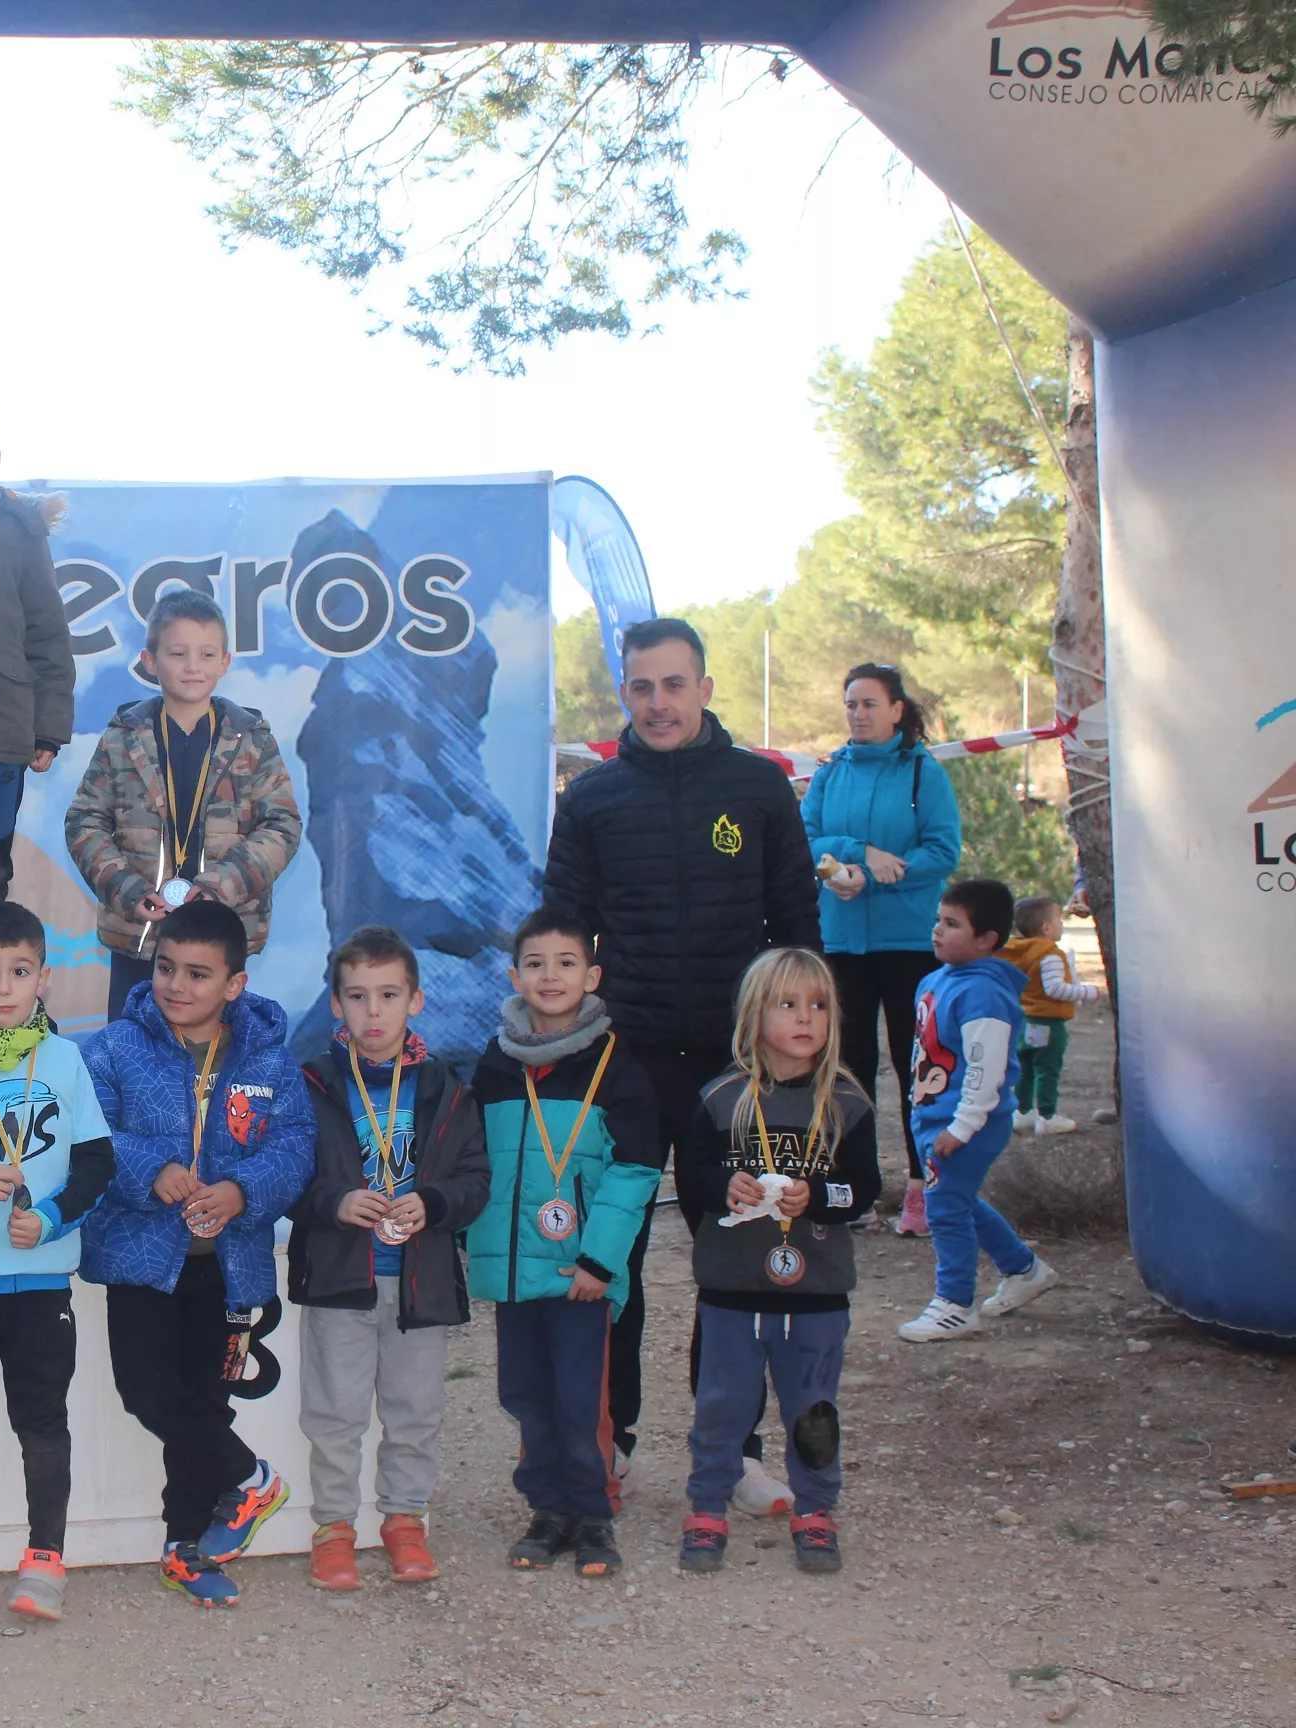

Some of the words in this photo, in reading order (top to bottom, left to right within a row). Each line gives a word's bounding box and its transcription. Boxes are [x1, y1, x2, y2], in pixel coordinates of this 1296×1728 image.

[988, 36, 1083, 80] Los
[988, 81, 1108, 105] CONSEJO
[1117, 80, 1266, 105] COMARCAL
[745, 1159, 781, 1167] FORE
[787, 1159, 830, 1172] AWAEN
